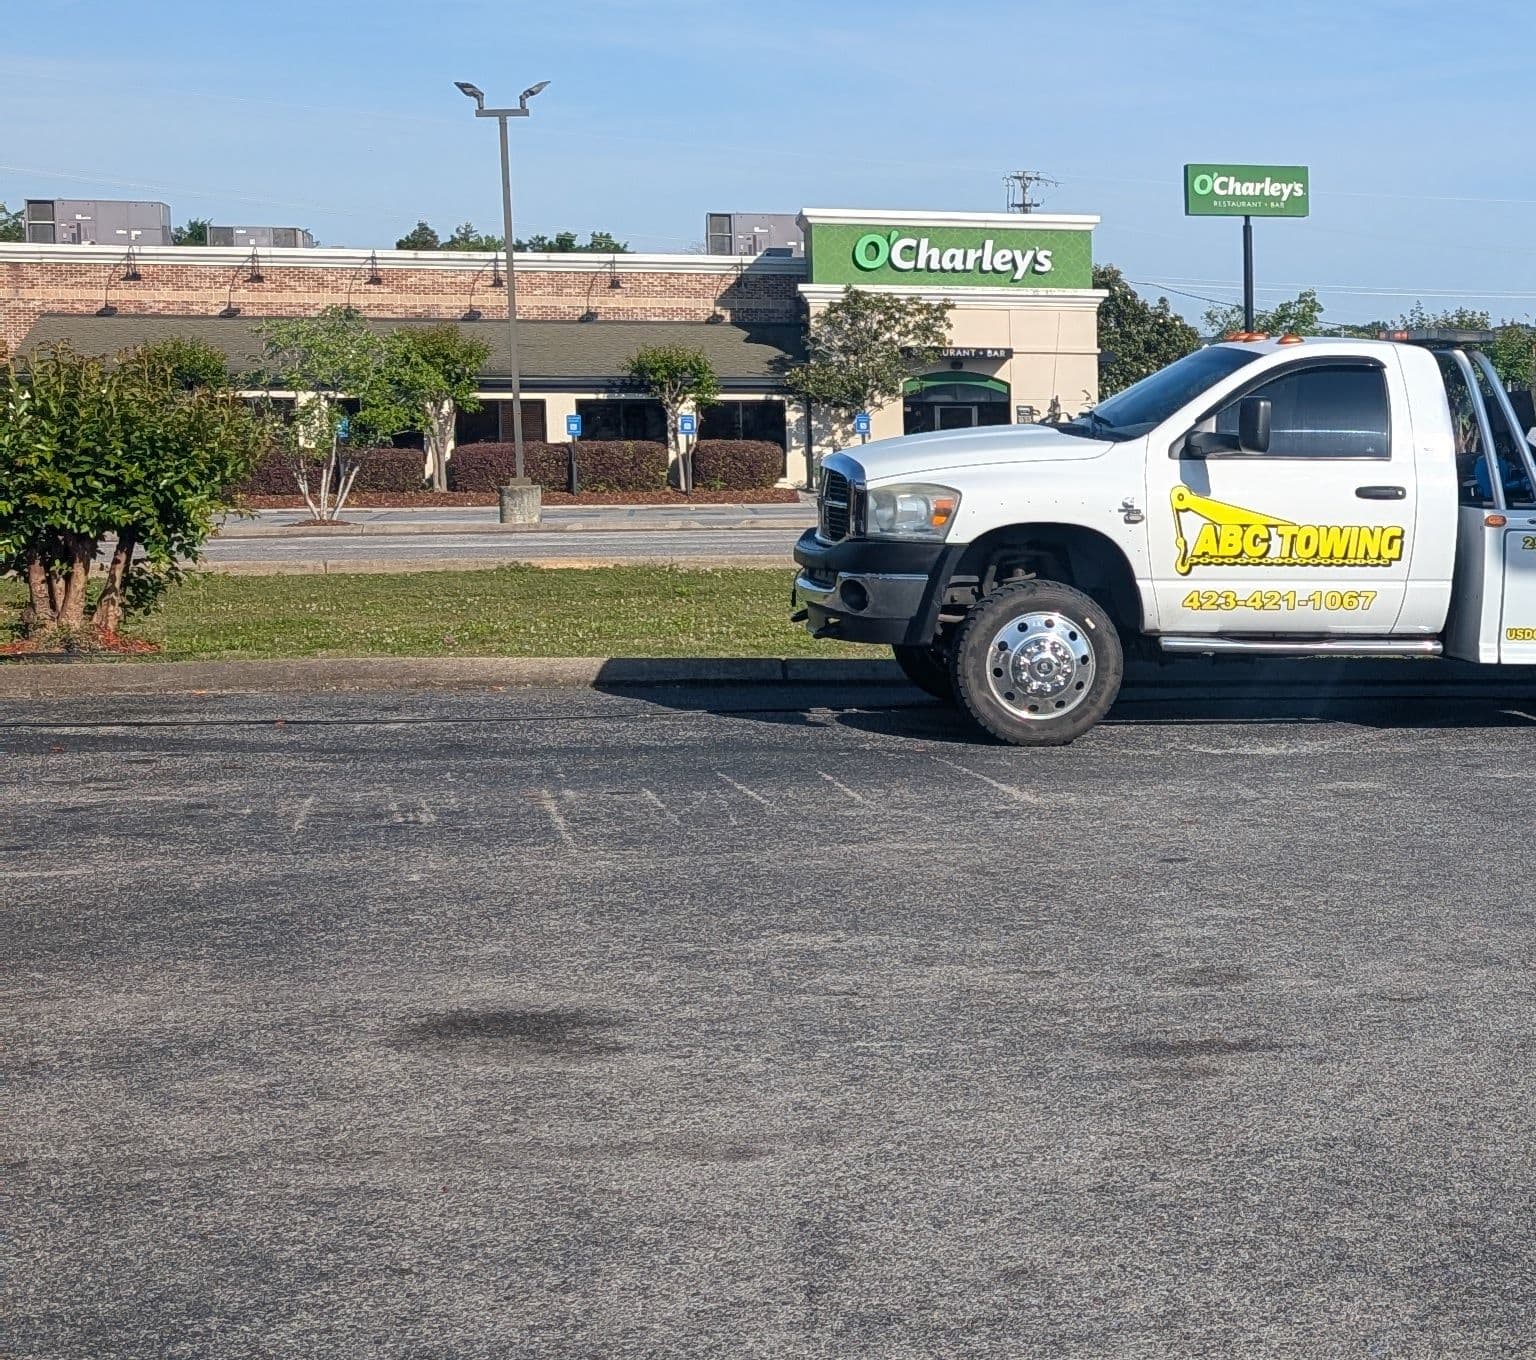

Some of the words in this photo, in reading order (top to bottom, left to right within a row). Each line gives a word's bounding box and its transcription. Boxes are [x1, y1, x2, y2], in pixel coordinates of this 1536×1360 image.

[1193, 172, 1306, 202] O'Charley's
[1213, 200, 1262, 209] RESTAURANT
[1270, 201, 1285, 209] BAR
[854, 230, 1054, 281] O'Charley's
[986, 349, 1006, 358] BAR
[1191, 523, 1271, 558] ABC
[1277, 525, 1404, 561] TOWING
[1182, 591, 1377, 611] 423-421-1067
